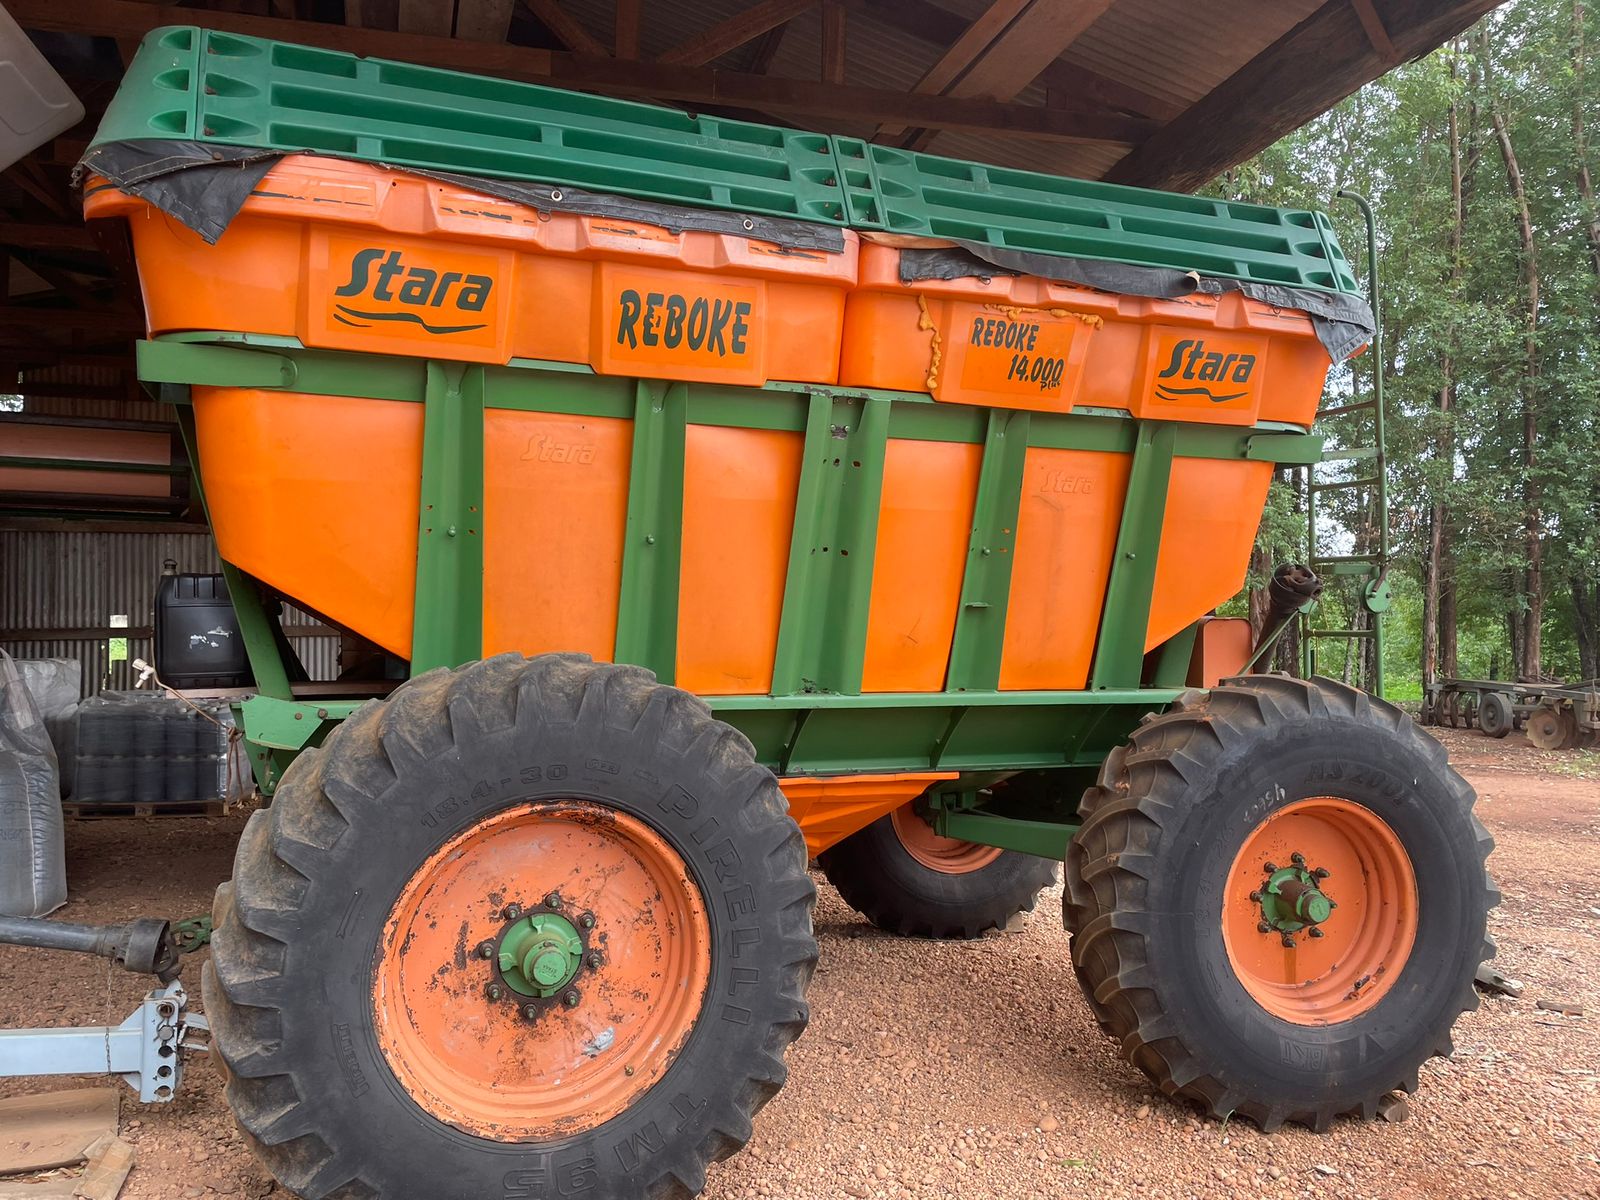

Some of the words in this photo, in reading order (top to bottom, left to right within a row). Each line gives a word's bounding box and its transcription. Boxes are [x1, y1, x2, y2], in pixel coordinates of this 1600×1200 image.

[334, 248, 494, 312] Stara
[617, 289, 752, 357] REBOKE
[971, 317, 1040, 353] REBOKE
[1008, 354, 1065, 382] 14.000
[1158, 339, 1256, 383] Stara
[521, 433, 597, 466] Stara
[1041, 471, 1096, 495] Stara
[657, 784, 760, 1025] PIRELLI
[1280, 1039, 1324, 1071] BKT
